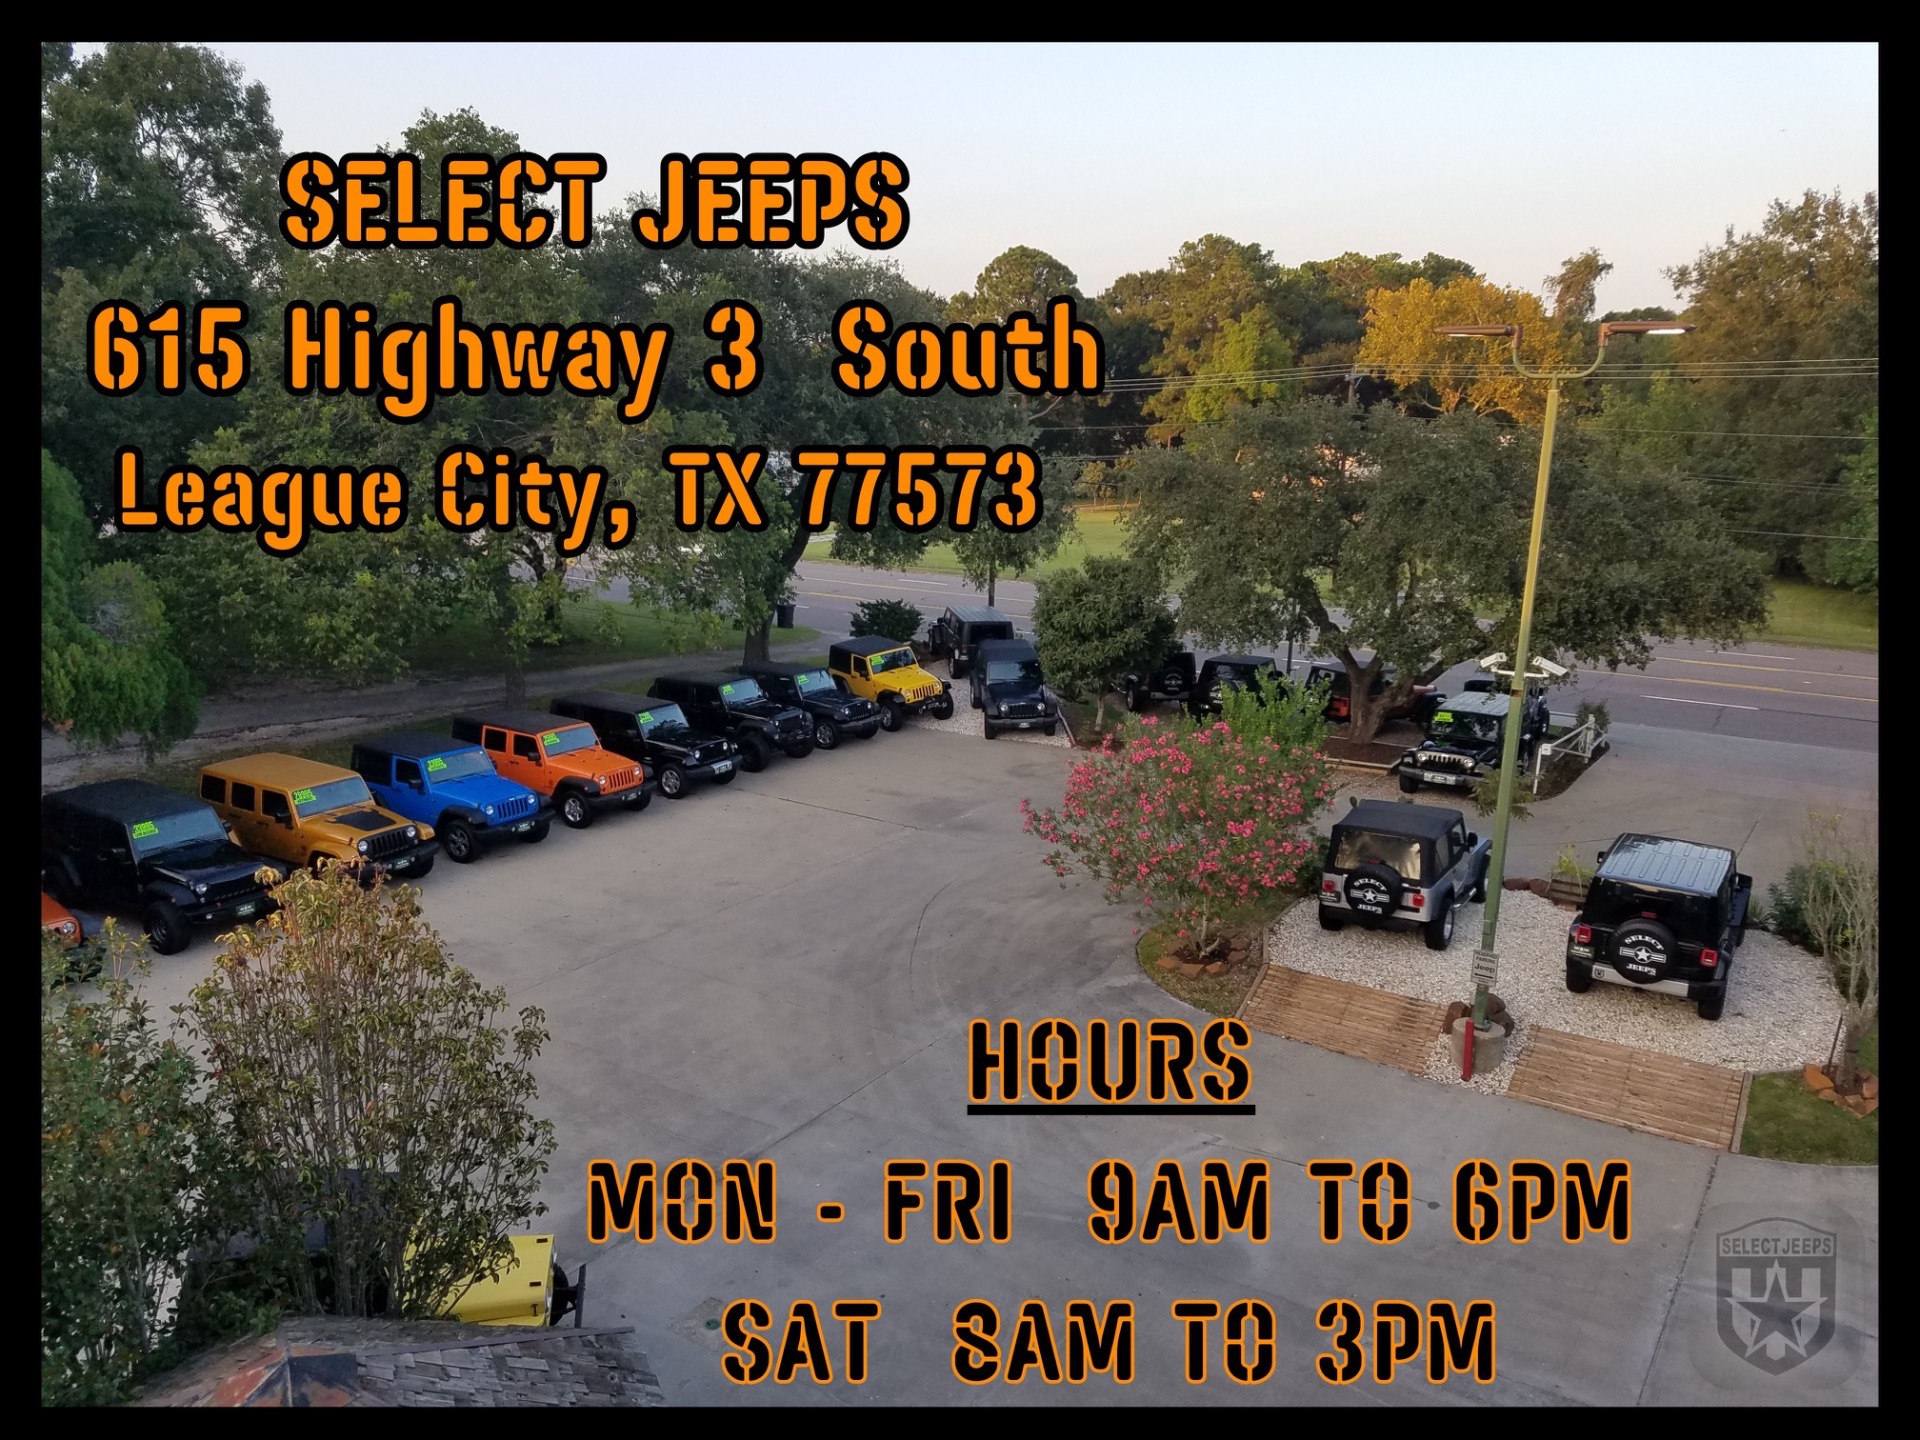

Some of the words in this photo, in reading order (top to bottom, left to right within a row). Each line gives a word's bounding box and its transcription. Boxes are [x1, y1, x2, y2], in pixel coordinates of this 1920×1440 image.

[1353, 878, 1388, 891] SELECT
[1357, 903, 1383, 914] JEEPS
[1624, 934, 1665, 951] SELECT
[1474, 963, 1496, 974] Jeep
[1626, 963, 1657, 976] JEEPS
